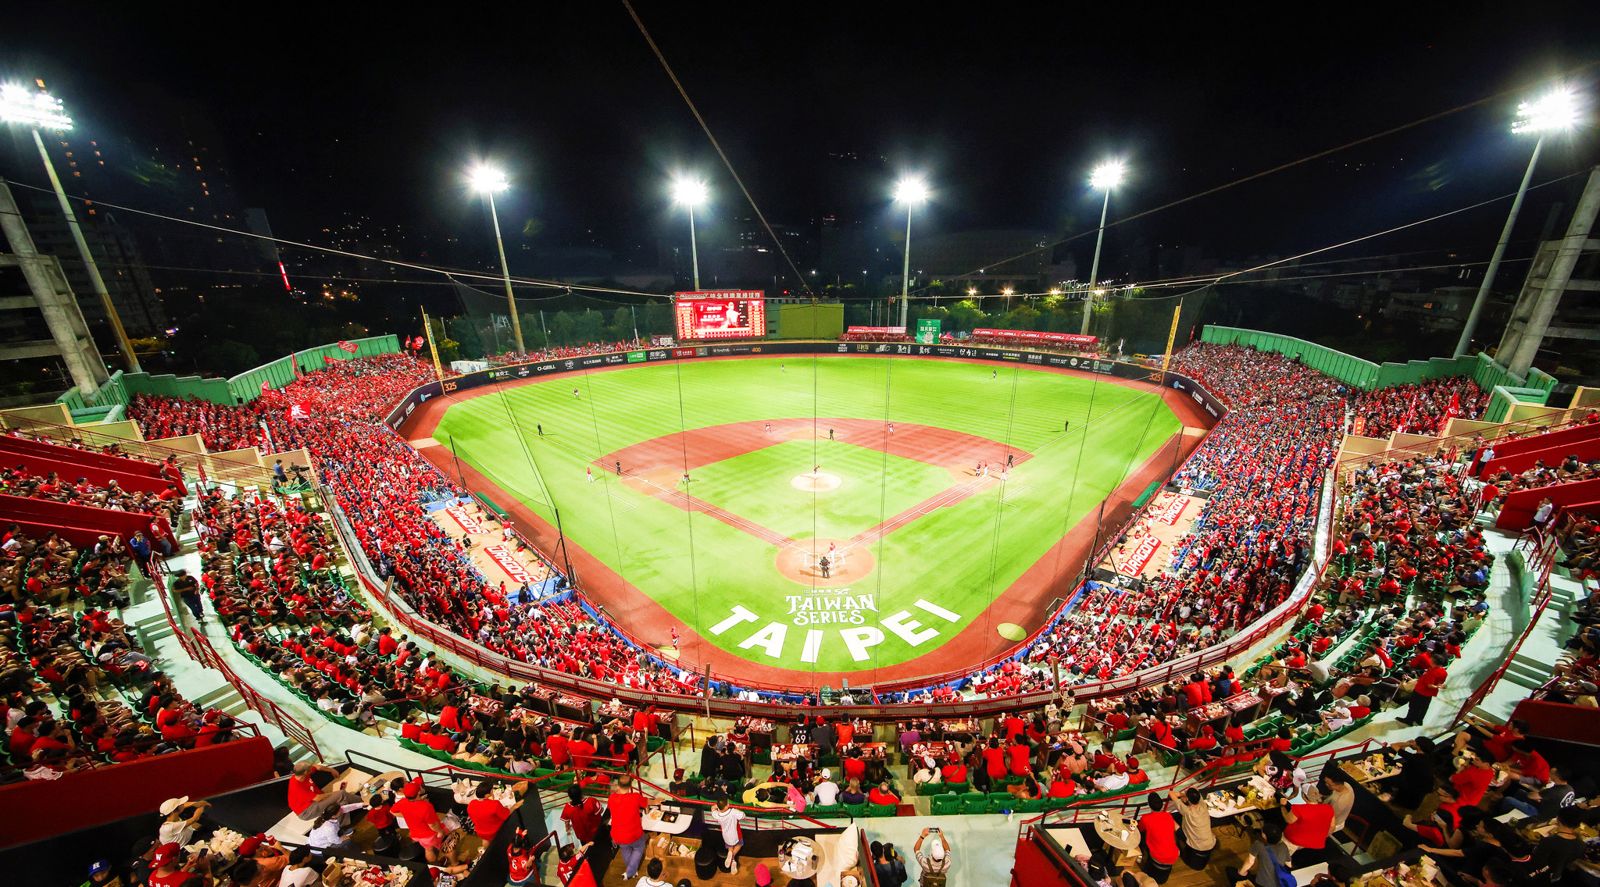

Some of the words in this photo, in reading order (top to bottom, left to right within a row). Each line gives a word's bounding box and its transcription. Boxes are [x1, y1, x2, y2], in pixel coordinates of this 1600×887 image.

[444, 381, 457, 391] 325
[1149, 373, 1162, 382] 325
[1118, 532, 1162, 577] DRAGONS
[785, 593, 879, 615] TAIWAN
[793, 609, 865, 626] SERIES
[708, 598, 962, 663] TAIPEI
[795, 734, 807, 744] 69
